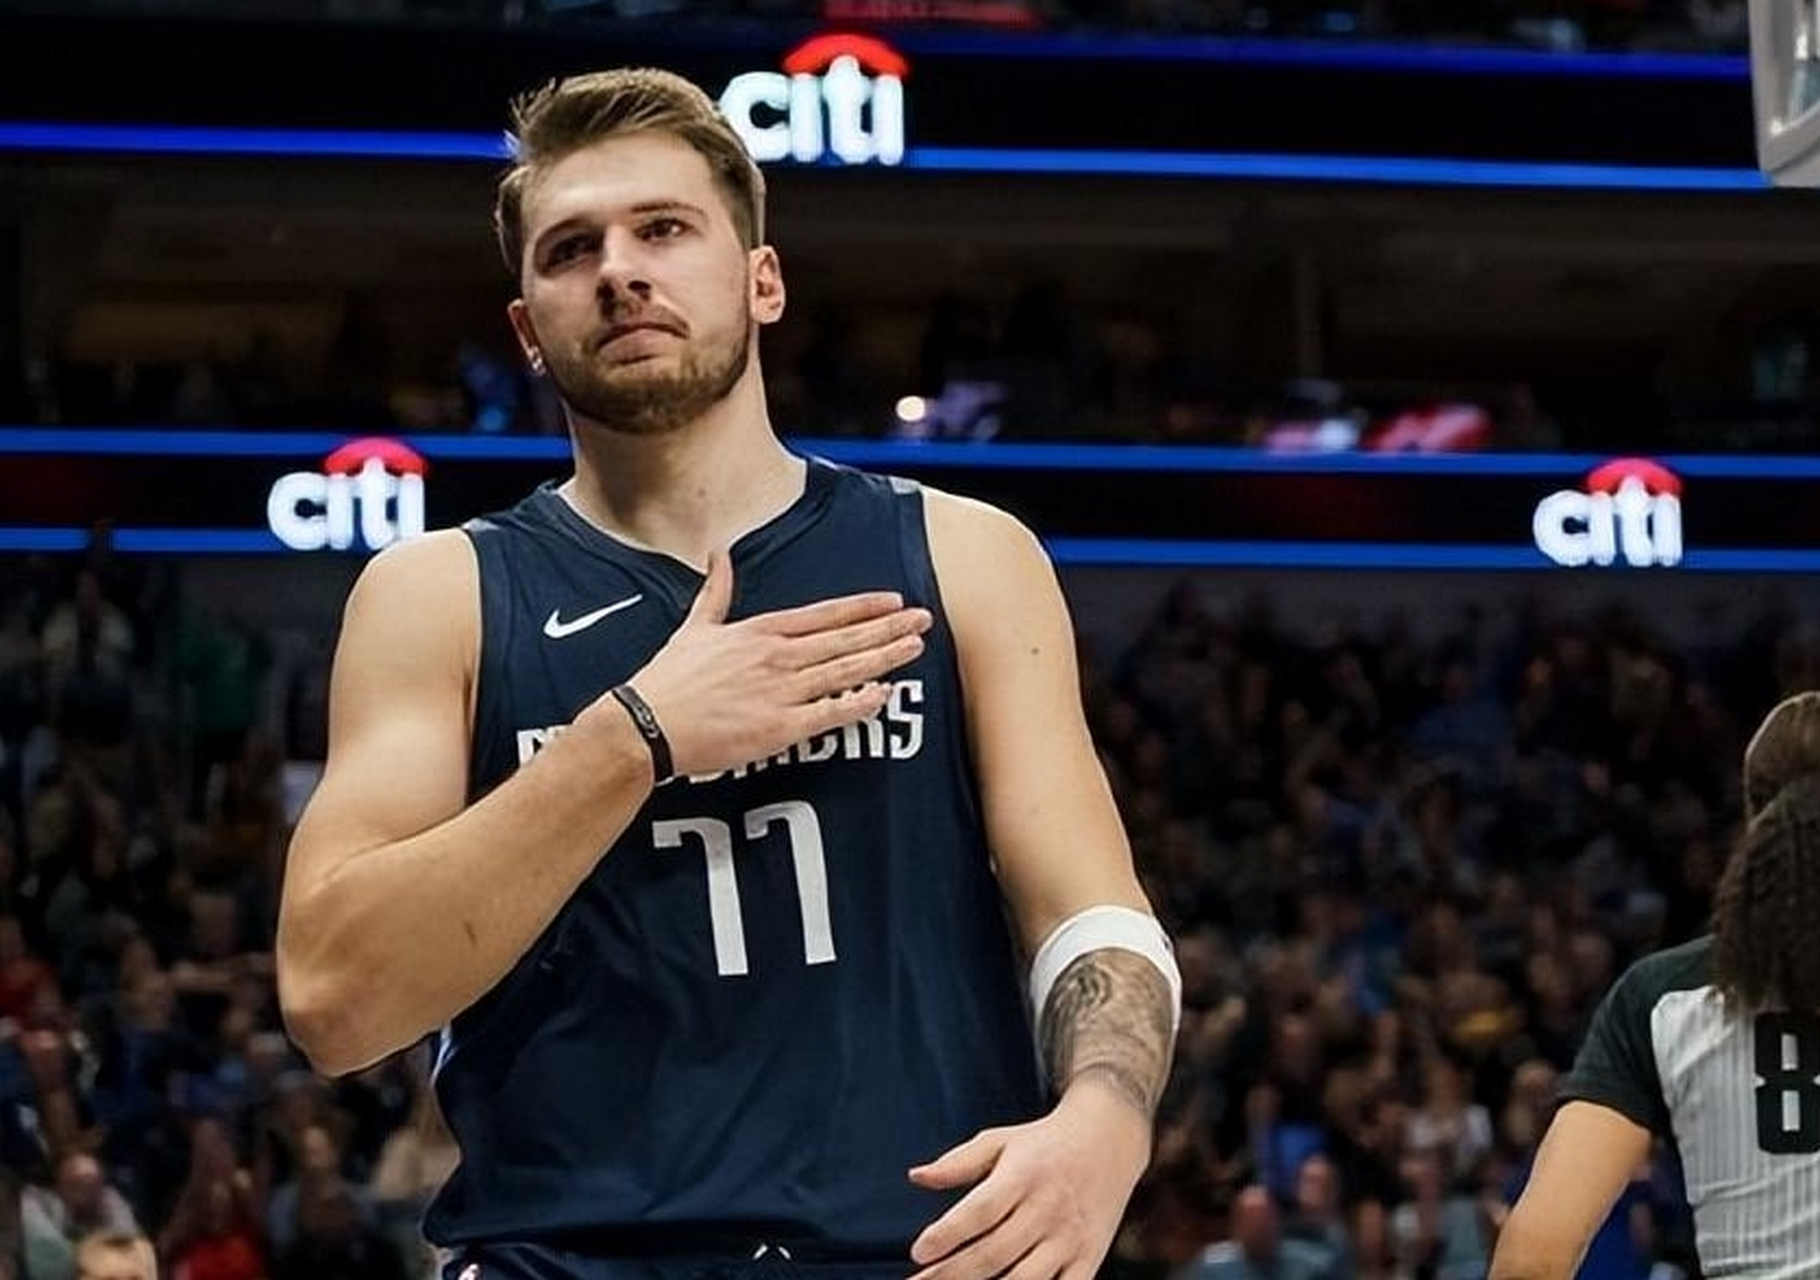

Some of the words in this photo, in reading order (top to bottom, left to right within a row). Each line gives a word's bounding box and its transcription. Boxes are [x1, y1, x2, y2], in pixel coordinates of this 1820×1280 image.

[718, 54, 904, 165] citi
[267, 457, 425, 551] citi
[1533, 475, 1683, 567] citi
[652, 800, 837, 976] 77
